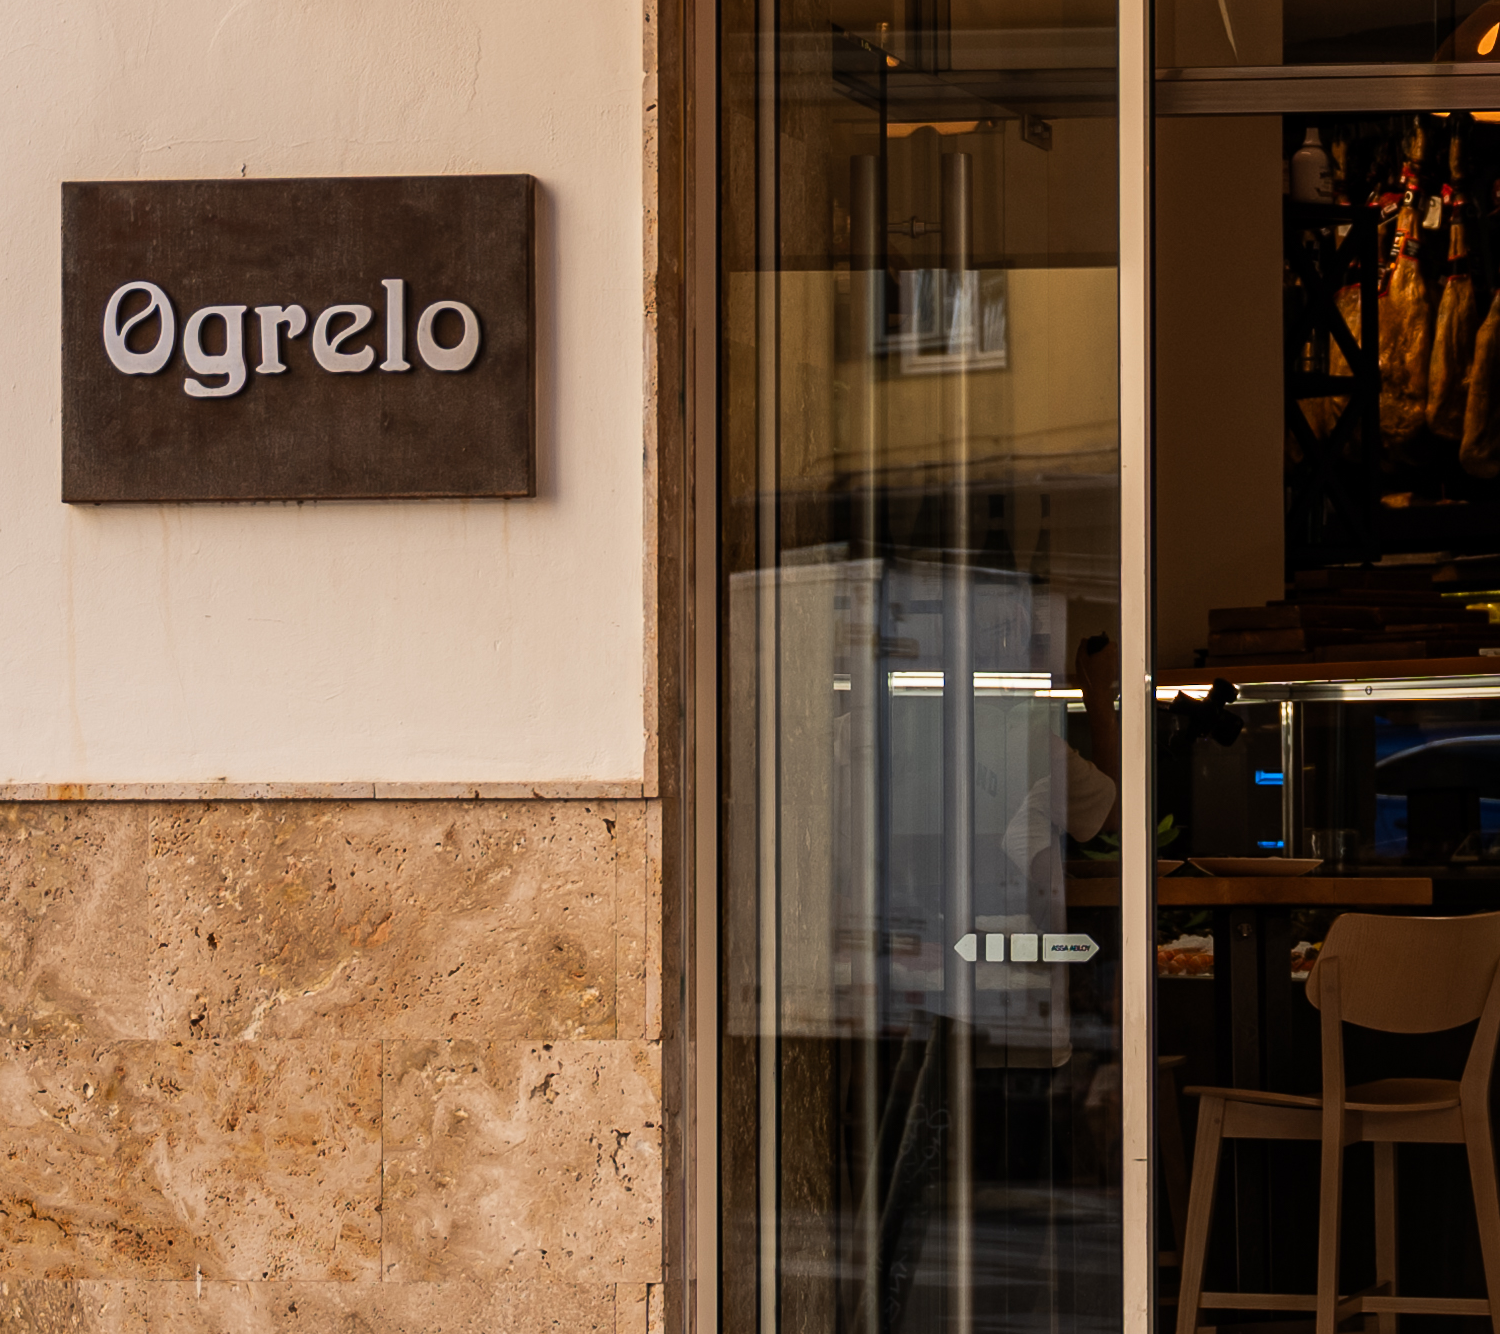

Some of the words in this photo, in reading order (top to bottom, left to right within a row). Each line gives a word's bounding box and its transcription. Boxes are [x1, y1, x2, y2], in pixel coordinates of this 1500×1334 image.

[102, 278, 481, 399] Ogrelo
[1051, 944, 1069, 952] ASSA
[1069, 944, 1091, 952] ABLOY
